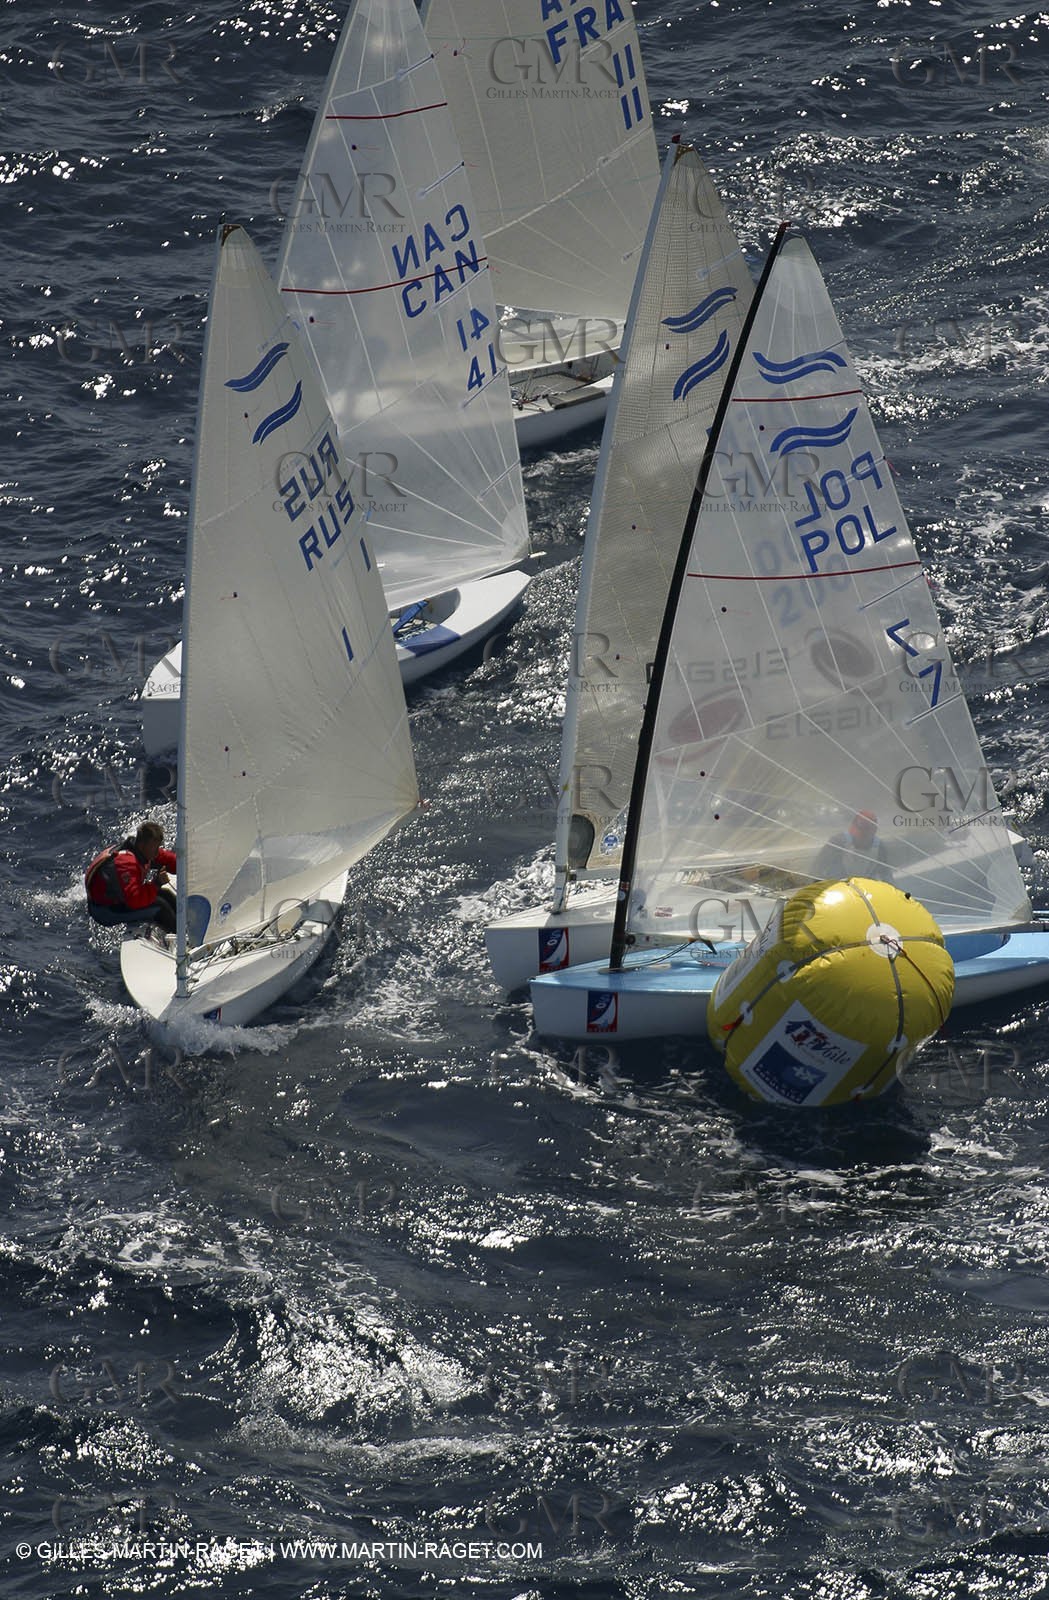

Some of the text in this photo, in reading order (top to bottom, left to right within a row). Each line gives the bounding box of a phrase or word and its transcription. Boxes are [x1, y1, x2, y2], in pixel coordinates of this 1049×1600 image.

[546, 0, 625, 65] FRA
[620, 85, 644, 131] 11
[401, 239, 480, 318] CAN
[467, 342, 498, 392] 41
[298, 479, 356, 572] RUS
[800, 504, 898, 574] POL
